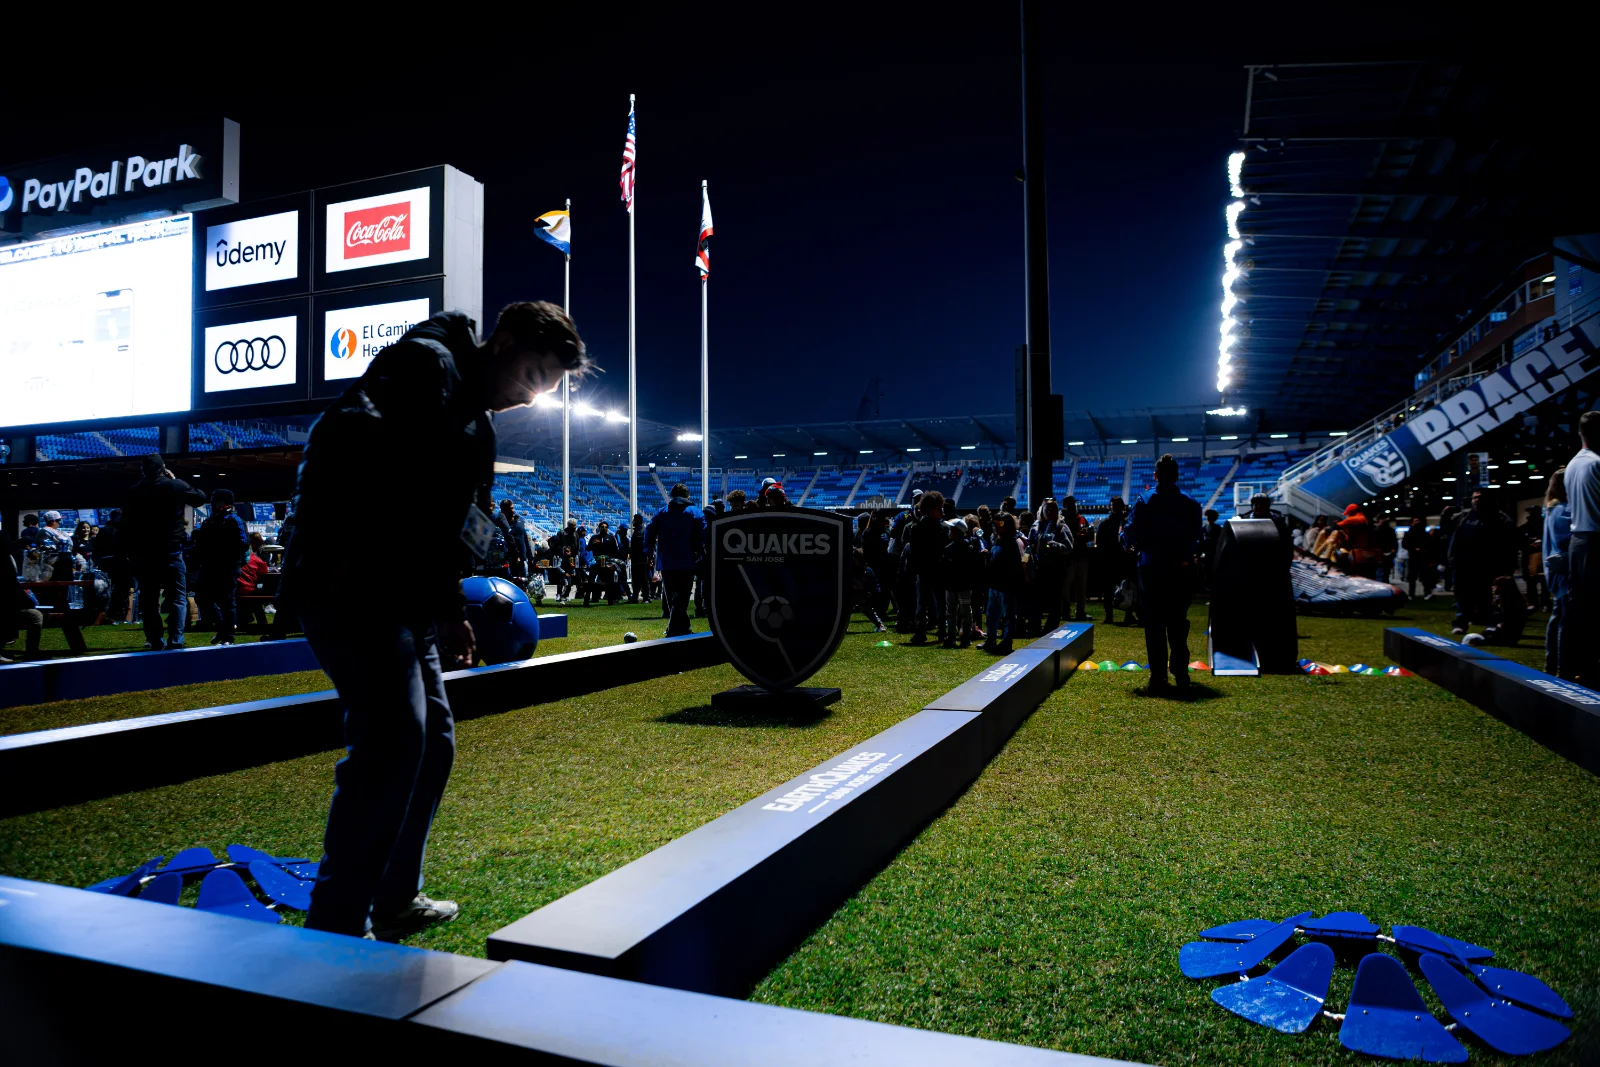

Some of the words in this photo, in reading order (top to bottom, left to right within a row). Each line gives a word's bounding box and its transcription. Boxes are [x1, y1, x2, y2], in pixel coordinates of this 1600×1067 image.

[22, 160, 122, 212] PayPal
[125, 144, 202, 191] Park
[346, 213, 408, 247] Coca-Cola
[363, 324, 373, 339] El
[378, 320, 416, 338] Camin
[1348, 439, 1389, 468] QUAKES
[722, 528, 831, 555] QUAKES
[761, 751, 887, 812] EARTHQUAKES
